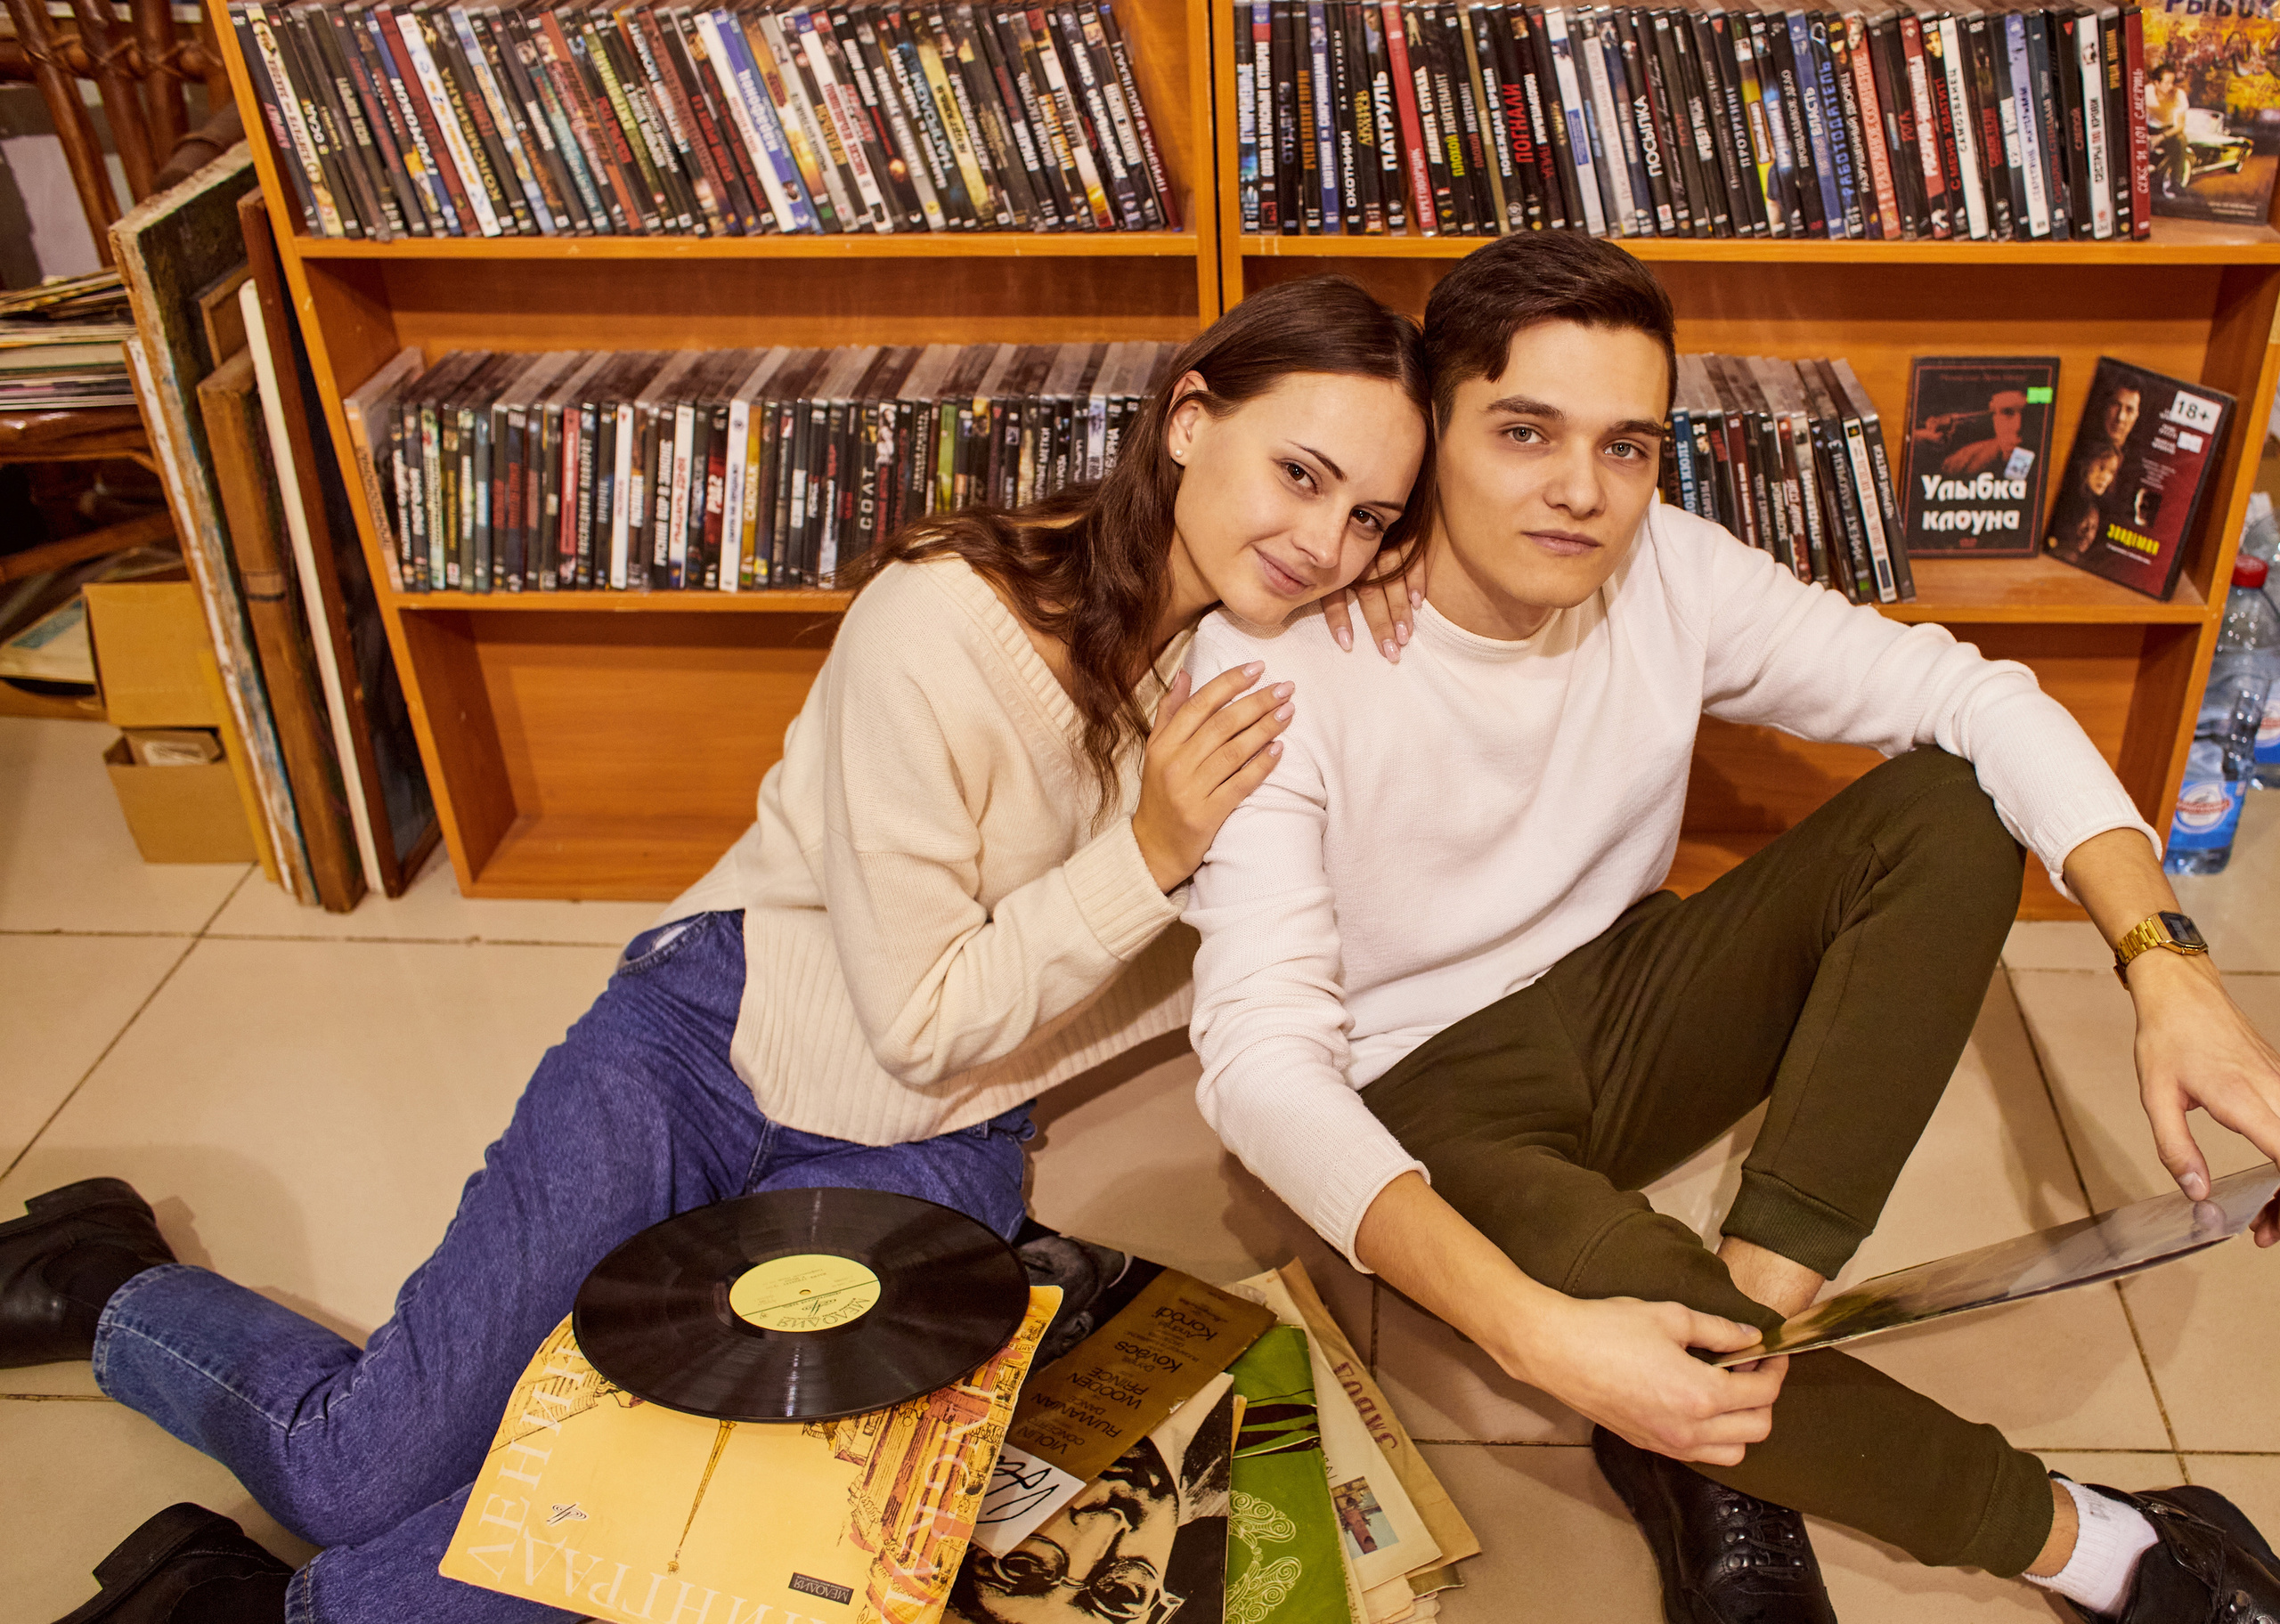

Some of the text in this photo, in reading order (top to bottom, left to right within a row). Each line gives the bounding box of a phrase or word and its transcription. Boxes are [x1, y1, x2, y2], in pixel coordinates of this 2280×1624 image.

[908, 71, 955, 169] НАПРОЛОМ
[1370, 70, 1400, 170] ПАТРУЛЬ
[1501, 83, 1535, 162] ПОГНАЛИ
[1803, 86, 1823, 135] ВЛАСТЬ
[1818, 61, 1854, 195] РАБОТОДАТЕЛЬ
[1947, 68, 1967, 151] САМОЗВАНЕЦ
[1443, 134, 1465, 175] ПЛОХОЙ
[1632, 94, 1663, 176] ПОСЫЛКА
[1943, 137, 1958, 176] МЕНЯ
[2178, 401, 2210, 422] 18+
[1828, 439, 1843, 449] 3
[1921, 472, 2027, 501] Улыбка
[1922, 510, 2020, 535] клоуна
[776, 1297, 870, 1328] МЕЛОДИЯ
[1069, 1373, 1143, 1410] WOODEN
[1088, 1367, 1149, 1396] PRINCE
[1031, 1393, 1122, 1439] RUMANIAN
[1016, 1426, 1068, 1455] VIOLIN
[794, 1579, 848, 1604] МЕЛОДИЯ
